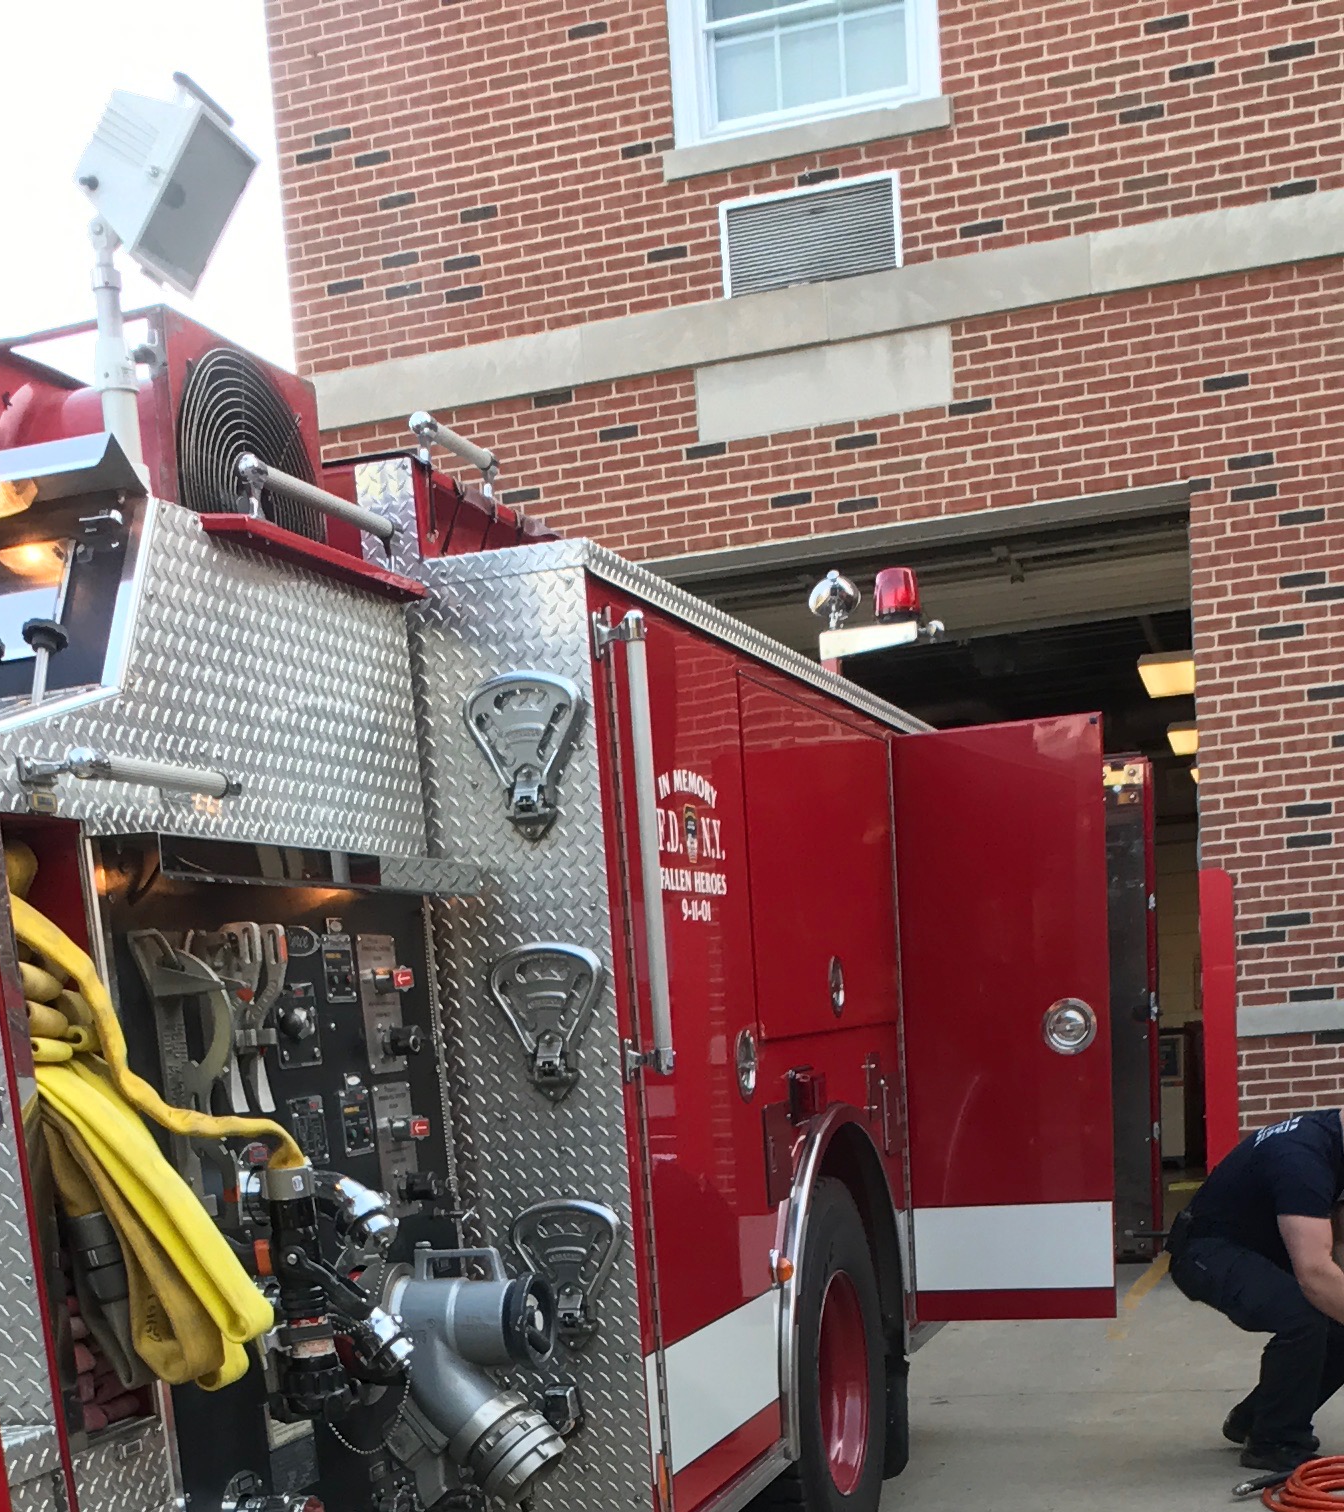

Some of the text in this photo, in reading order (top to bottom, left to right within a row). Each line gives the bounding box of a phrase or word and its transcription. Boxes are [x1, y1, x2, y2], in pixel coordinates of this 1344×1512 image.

[658, 769, 717, 809] IN MEMORY
[656, 808, 726, 861] F.D. N.Y.
[660, 867, 728, 896] FALLEN HEROES
[681, 898, 712, 922] 9-11-01
